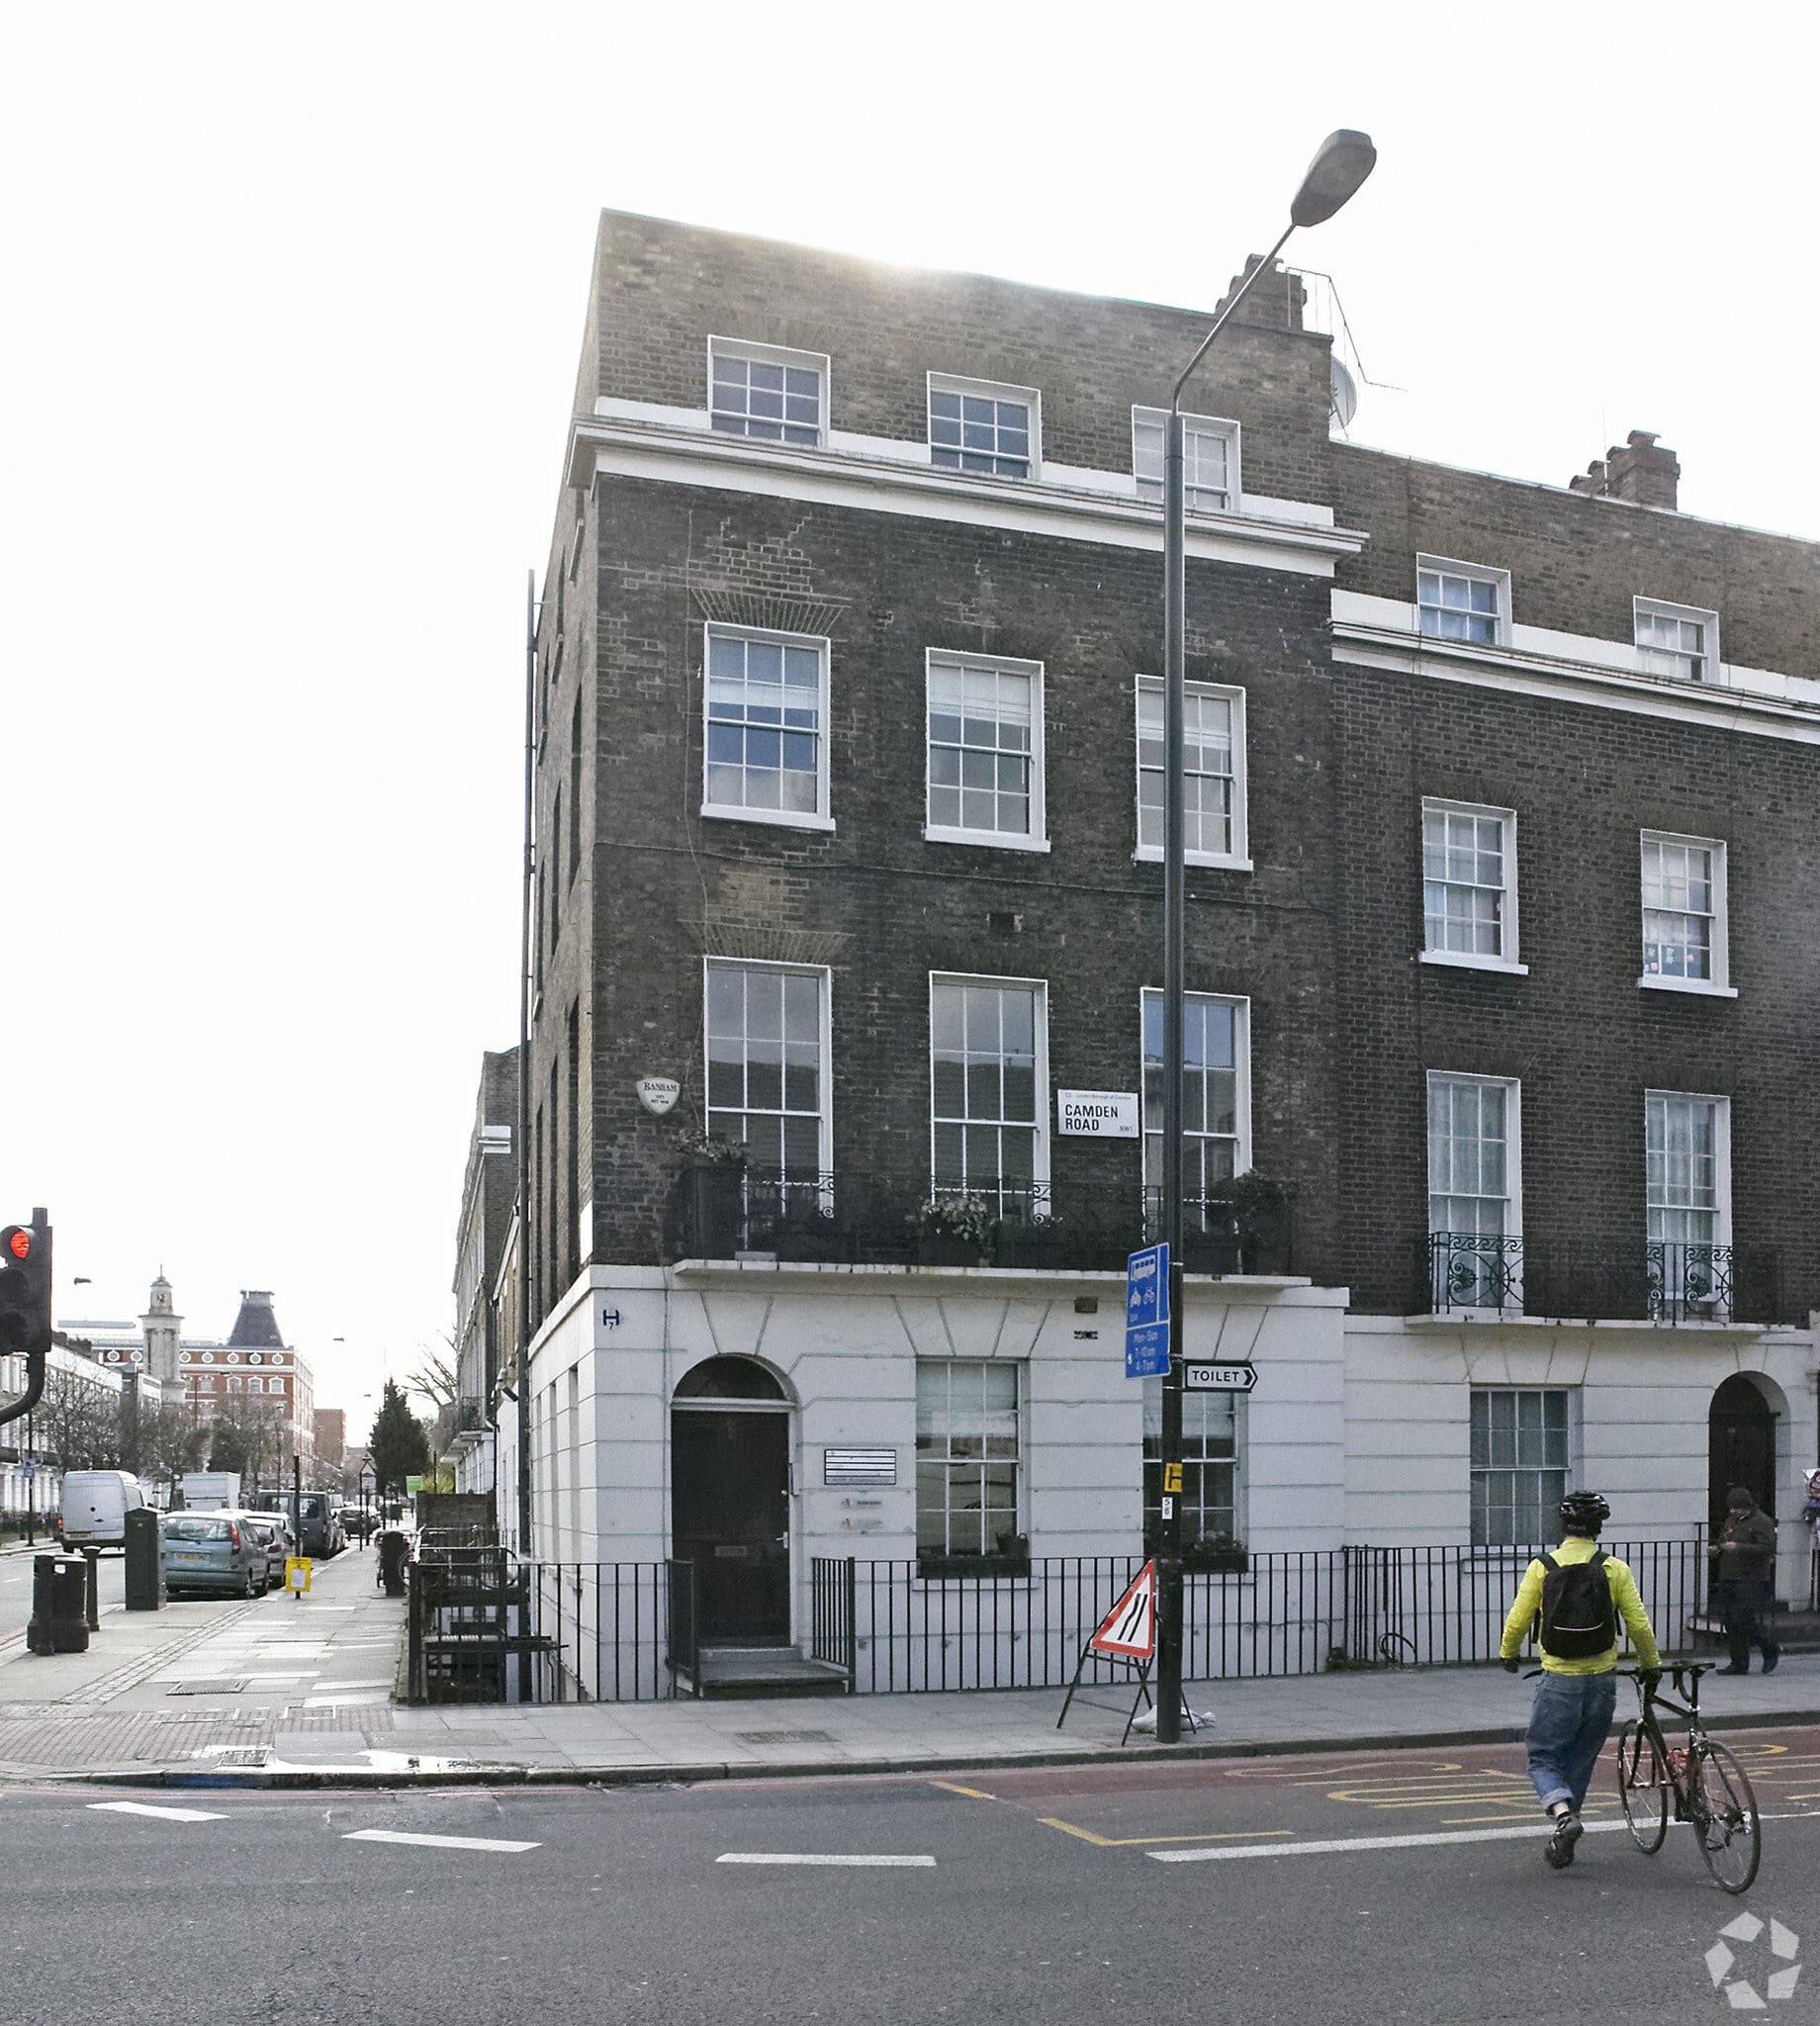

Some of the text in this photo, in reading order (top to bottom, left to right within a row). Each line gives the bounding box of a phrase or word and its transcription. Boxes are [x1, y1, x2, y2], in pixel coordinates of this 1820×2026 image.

[1064, 1104, 1119, 1118] CAMDEN
[1065, 1118, 1100, 1131] ROAD
[1192, 1370, 1239, 1382] TOILET
